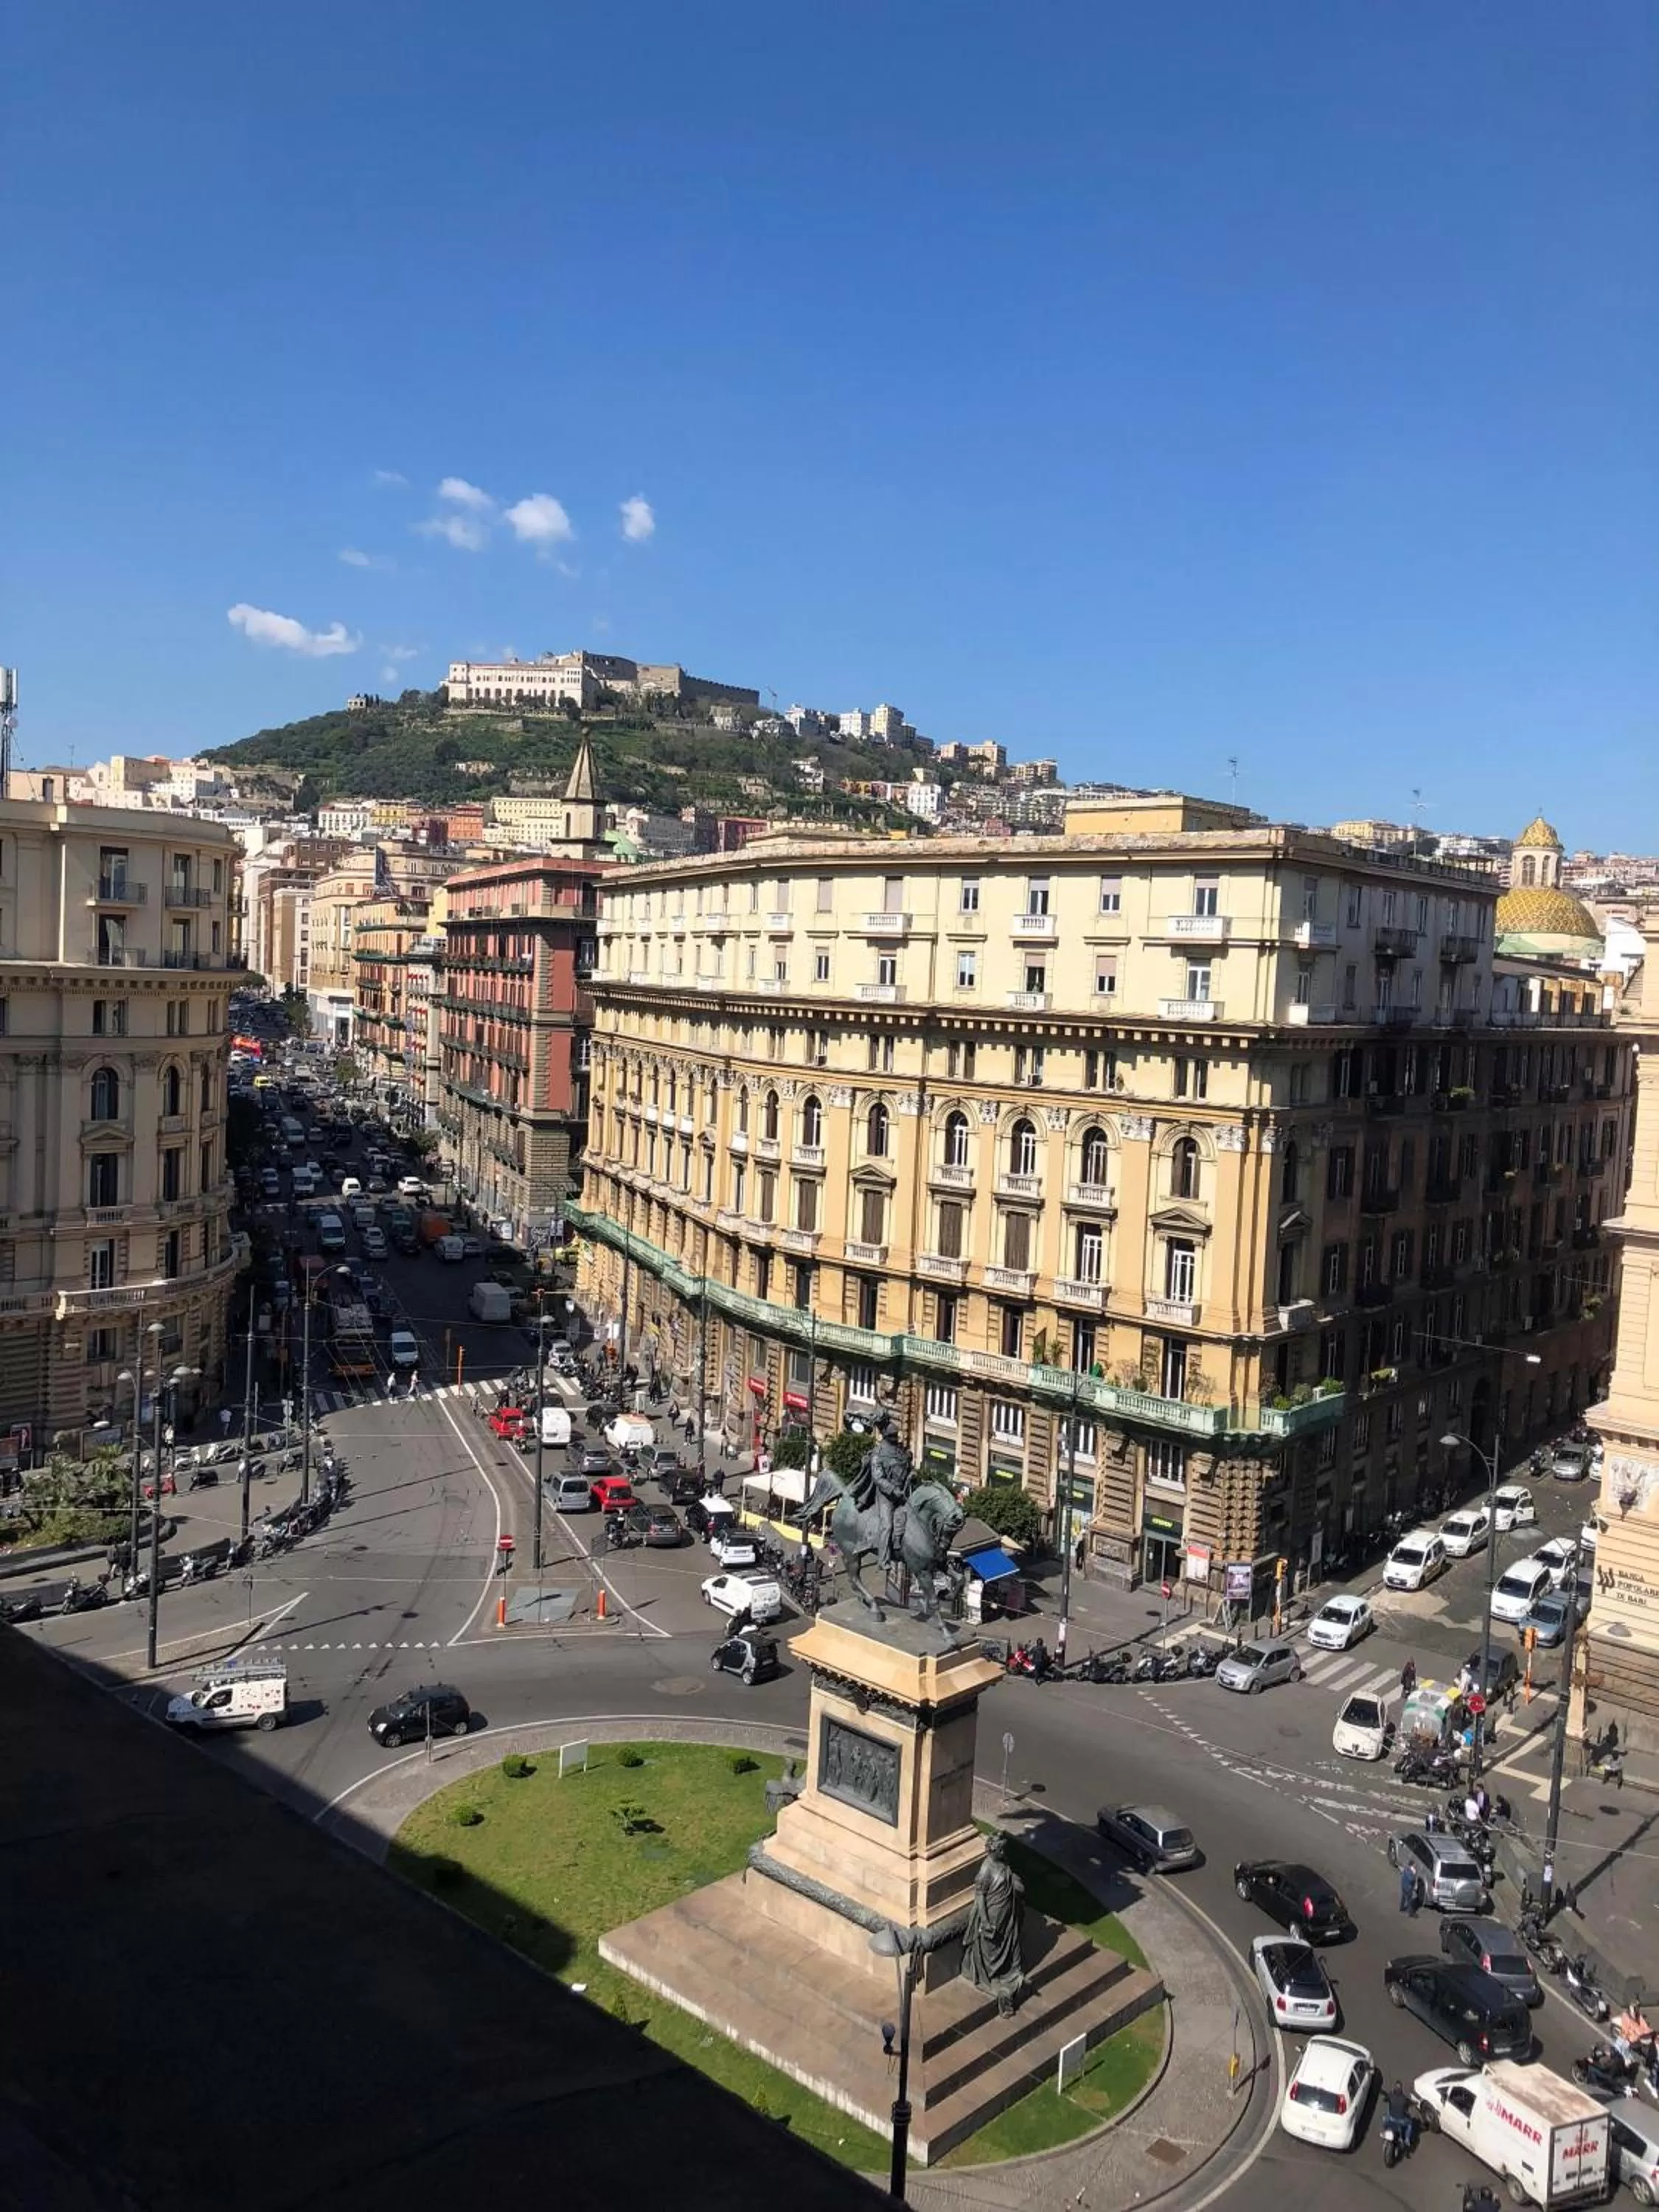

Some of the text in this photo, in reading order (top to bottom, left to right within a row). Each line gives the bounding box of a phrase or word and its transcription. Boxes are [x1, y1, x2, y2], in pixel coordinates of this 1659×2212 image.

[1618, 1570, 1645, 1583] BANCA
[1501, 2108, 1543, 2146] MARR
[1562, 2140, 1599, 2160] MARR
